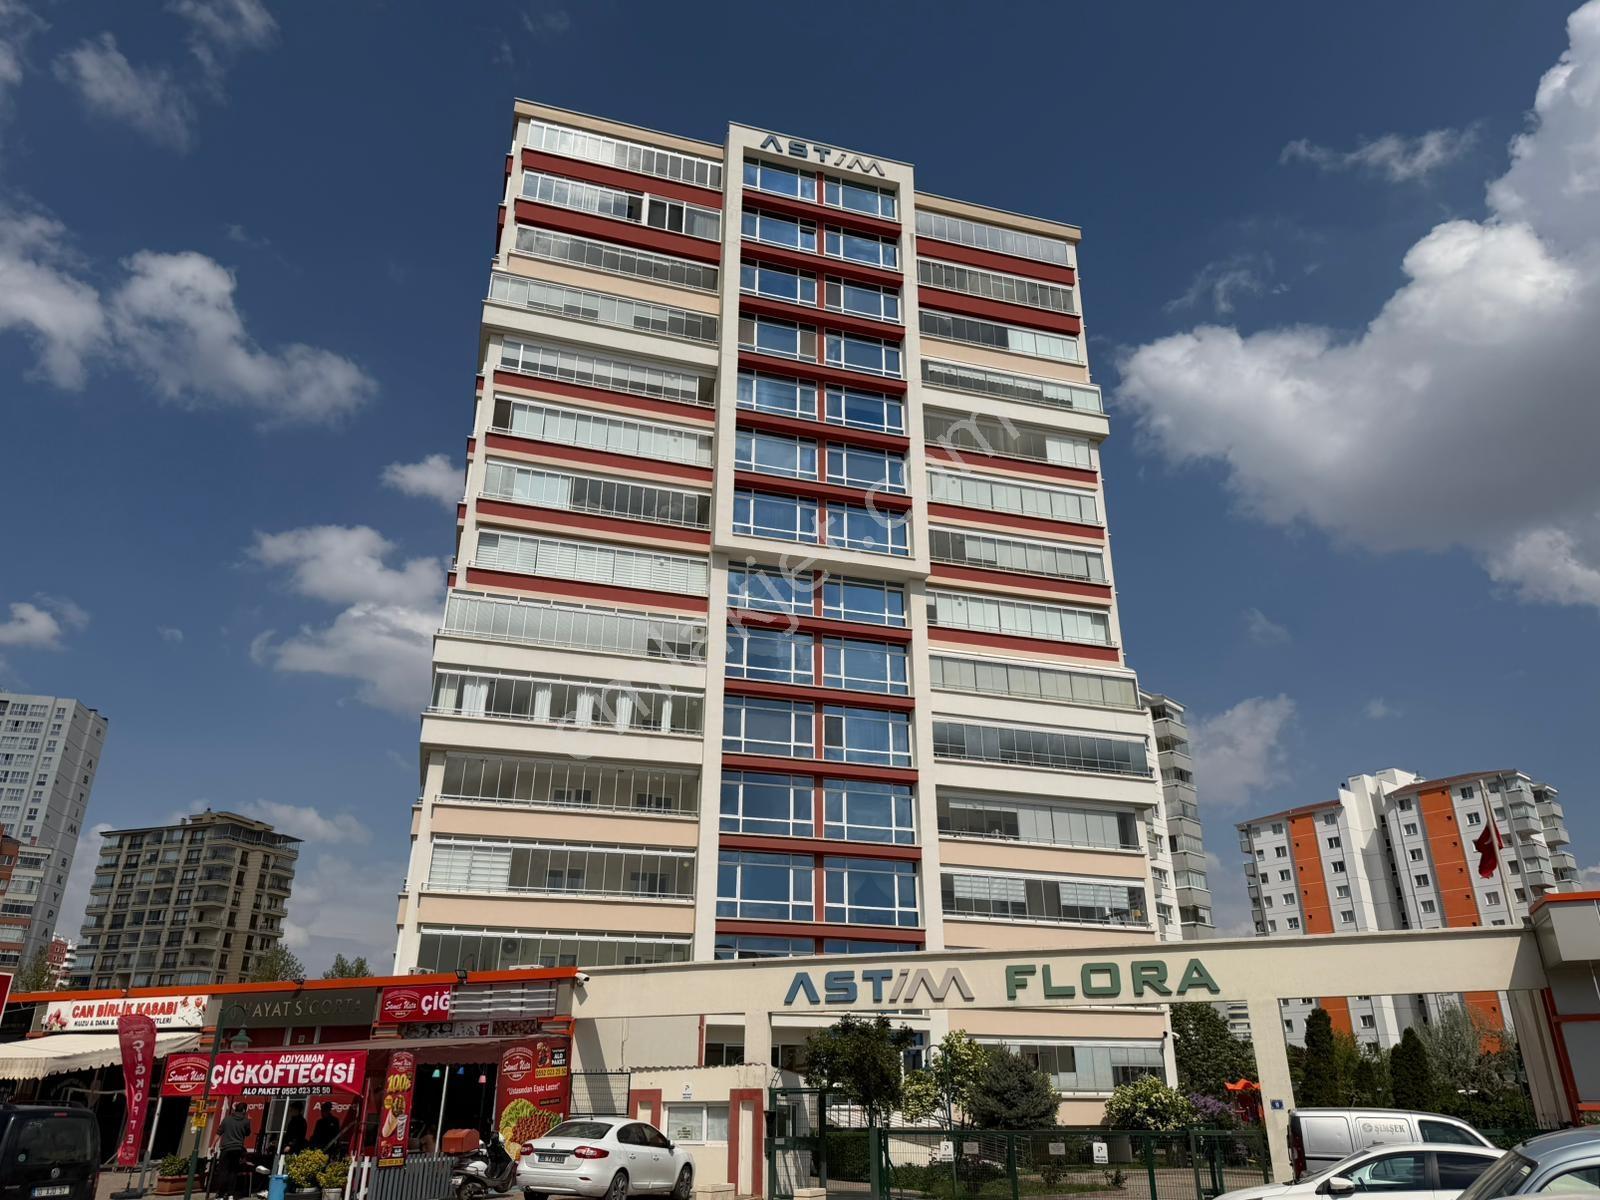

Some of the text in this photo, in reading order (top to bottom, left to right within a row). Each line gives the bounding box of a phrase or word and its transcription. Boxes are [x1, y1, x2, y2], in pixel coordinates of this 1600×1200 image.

[1005, 958, 1221, 1000] FLORA
[71, 1001, 179, 1019] CAN BİRLİK KASABI
[95, 1018, 109, 1026] DANA
[278, 1054, 325, 1064] ADIYAMAN
[210, 1057, 356, 1090] ÇİĞKÖFTECİSİ
[242, 1088, 257, 1096] ALO
[257, 1087, 280, 1096] PAKET
[281, 1087, 298, 1095] 0552
